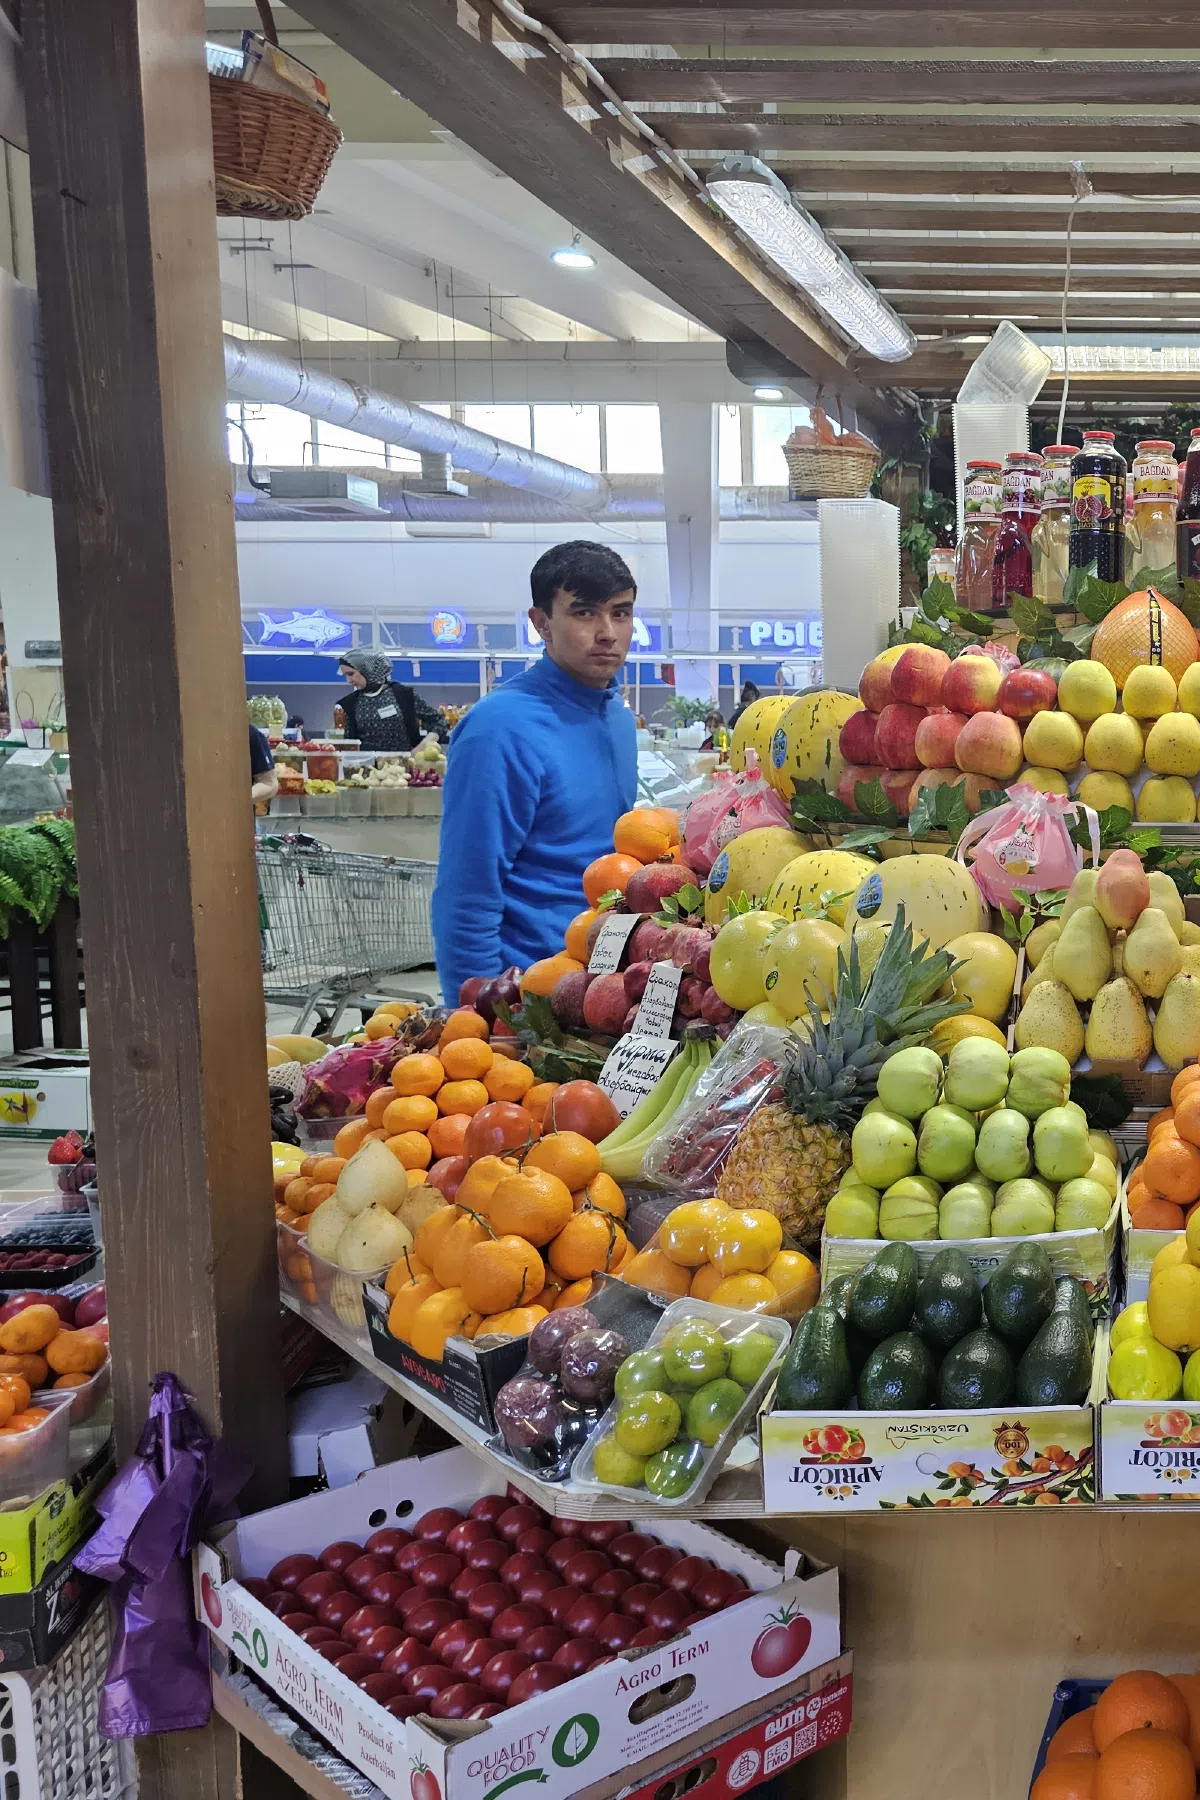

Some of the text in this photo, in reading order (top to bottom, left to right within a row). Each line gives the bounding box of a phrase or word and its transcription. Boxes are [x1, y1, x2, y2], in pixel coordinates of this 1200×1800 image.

[789, 1465, 885, 1485] APRICOT
[226, 1598, 252, 1625] QUALITY
[277, 1675, 344, 1745] AZERBAIJAN
[765, 1706, 804, 1741] BUTA
[358, 1721, 393, 1754] Product of
[467, 1725, 550, 1777] QUALITY
[767, 1741, 789, 1760] БЕЗ
[360, 1747, 396, 1780] Azerbaijan
[484, 1750, 536, 1787] FOOD
[767, 1752, 788, 1771] ГМО
